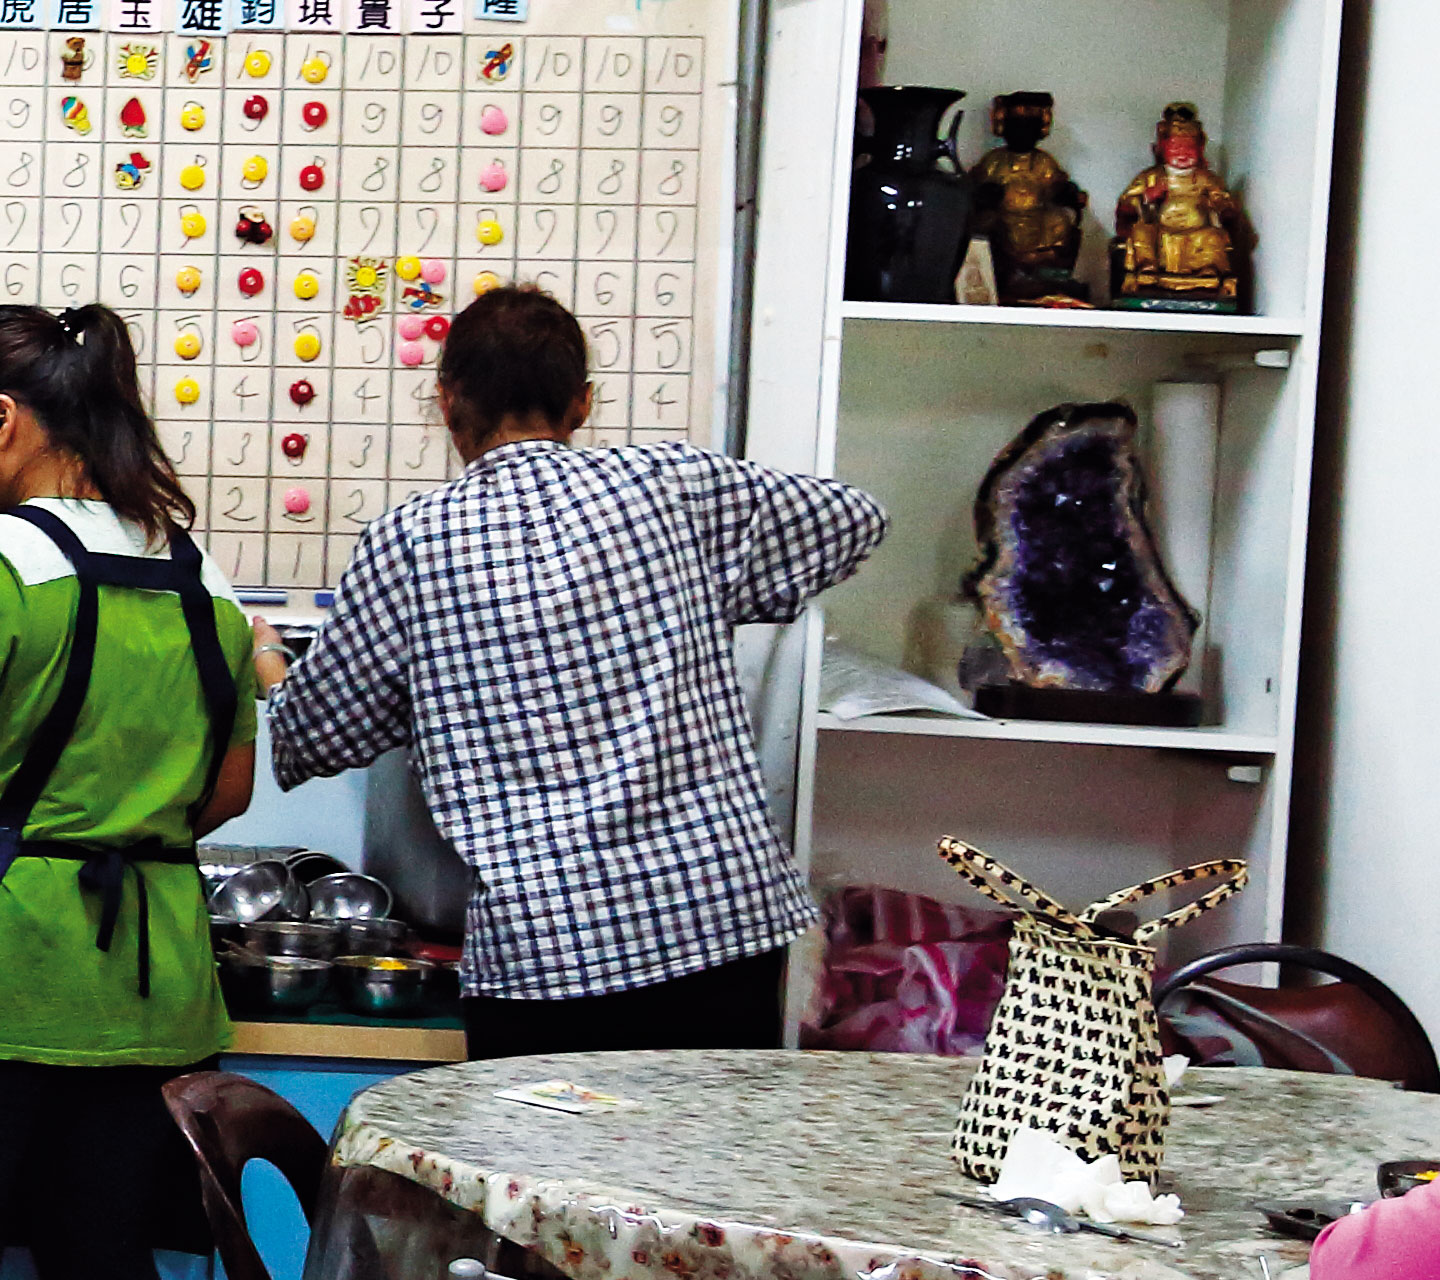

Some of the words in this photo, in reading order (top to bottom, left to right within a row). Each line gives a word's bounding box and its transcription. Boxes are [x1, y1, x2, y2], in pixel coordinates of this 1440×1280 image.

[4, 40, 38, 77] 10
[360, 47, 396, 81] 10
[418, 45, 453, 81] 10
[536, 48, 571, 82] 10
[599, 50, 632, 81] 10
[657, 48, 692, 82] 10
[10, 97, 31, 129] 9
[362, 103, 386, 135] 9
[421, 103, 443, 135] 9
[653, 272, 679, 307] 6
[650, 320, 682, 370] 5
[649, 381, 678, 419] 4
